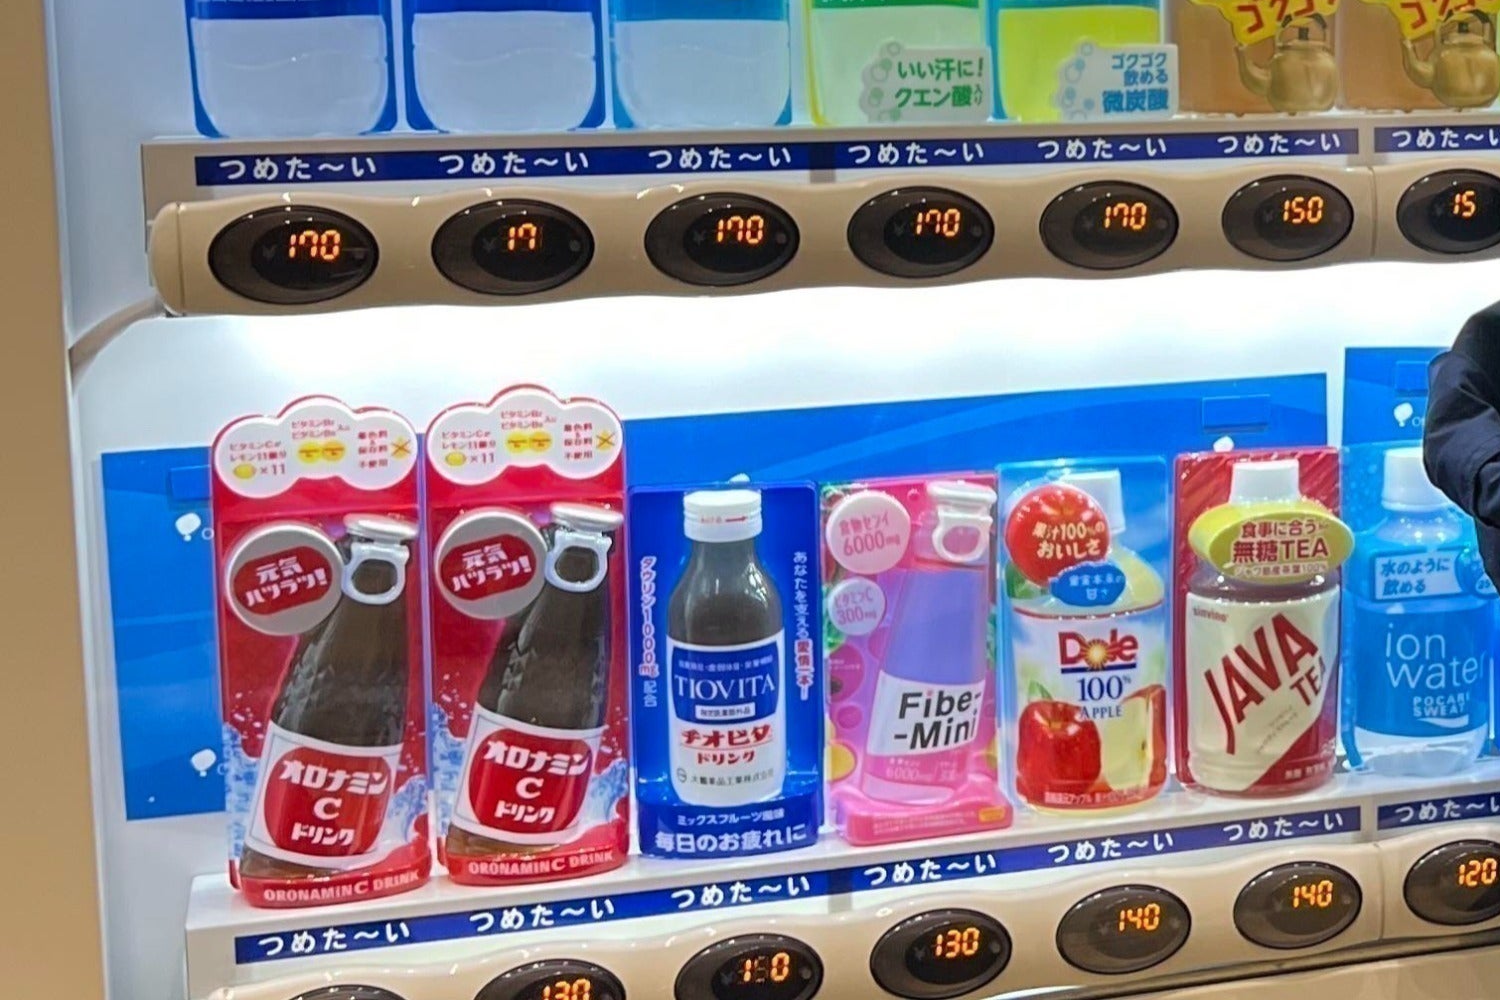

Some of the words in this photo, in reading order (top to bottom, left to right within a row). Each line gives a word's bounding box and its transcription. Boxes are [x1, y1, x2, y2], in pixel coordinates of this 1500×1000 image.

[1111, 53, 1167, 70] ゴクゴク
[1124, 69, 1169, 86] 飲める
[1102, 89, 1169, 113] 微炭酸
[916, 207, 961, 237] 170
[1104, 201, 1147, 230] 170
[1282, 196, 1324, 224] 150
[716, 215, 764, 245] 170
[288, 229, 340, 260] 170
[1241, 520, 1316, 540] 食事に合う
[462, 542, 508, 570] 元気
[1037, 538, 1101, 560] おいしさ
[1233, 538, 1329, 565] 無糖TEA
[256, 555, 303, 585] 元気
[451, 555, 532, 592] ハツラツ!
[1380, 558, 1451, 578] 水のように
[244, 567, 327, 607] ハツラツ!
[1382, 579, 1426, 596] 飲める
[1058, 628, 1139, 666] Dole
[1385, 622, 1446, 661] ion
[1204, 611, 1319, 756] JAVA
[1385, 650, 1486, 691] water
[674, 672, 776, 700] TIOVITA
[1413, 692, 1470, 708] POCARI
[1079, 704, 1122, 720] APPLE
[1413, 704, 1466, 718] SWEAT
[680, 723, 774, 750] チオビタ
[484, 740, 590, 776] オロナミン
[696, 751, 755, 766] ドリンク
[280, 759, 388, 795] オロナミン
[515, 777, 544, 799] C
[314, 797, 342, 820] C
[494, 800, 555, 824] ドリンク
[291, 822, 355, 847] ドリンク
[655, 823, 808, 855] 毎日のお疲れに
[468, 859, 550, 876] ORONAMIN
[550, 857, 567, 872] C
[569, 850, 614, 868] DRINK
[1457, 858, 1497, 887] 120
[263, 884, 353, 902] ORONAMIN
[353, 879, 370, 895] C
[372, 869, 420, 892] DRINK
[1293, 880, 1333, 908] 140
[1119, 904, 1161, 931] 140
[933, 926, 980, 957] 130
